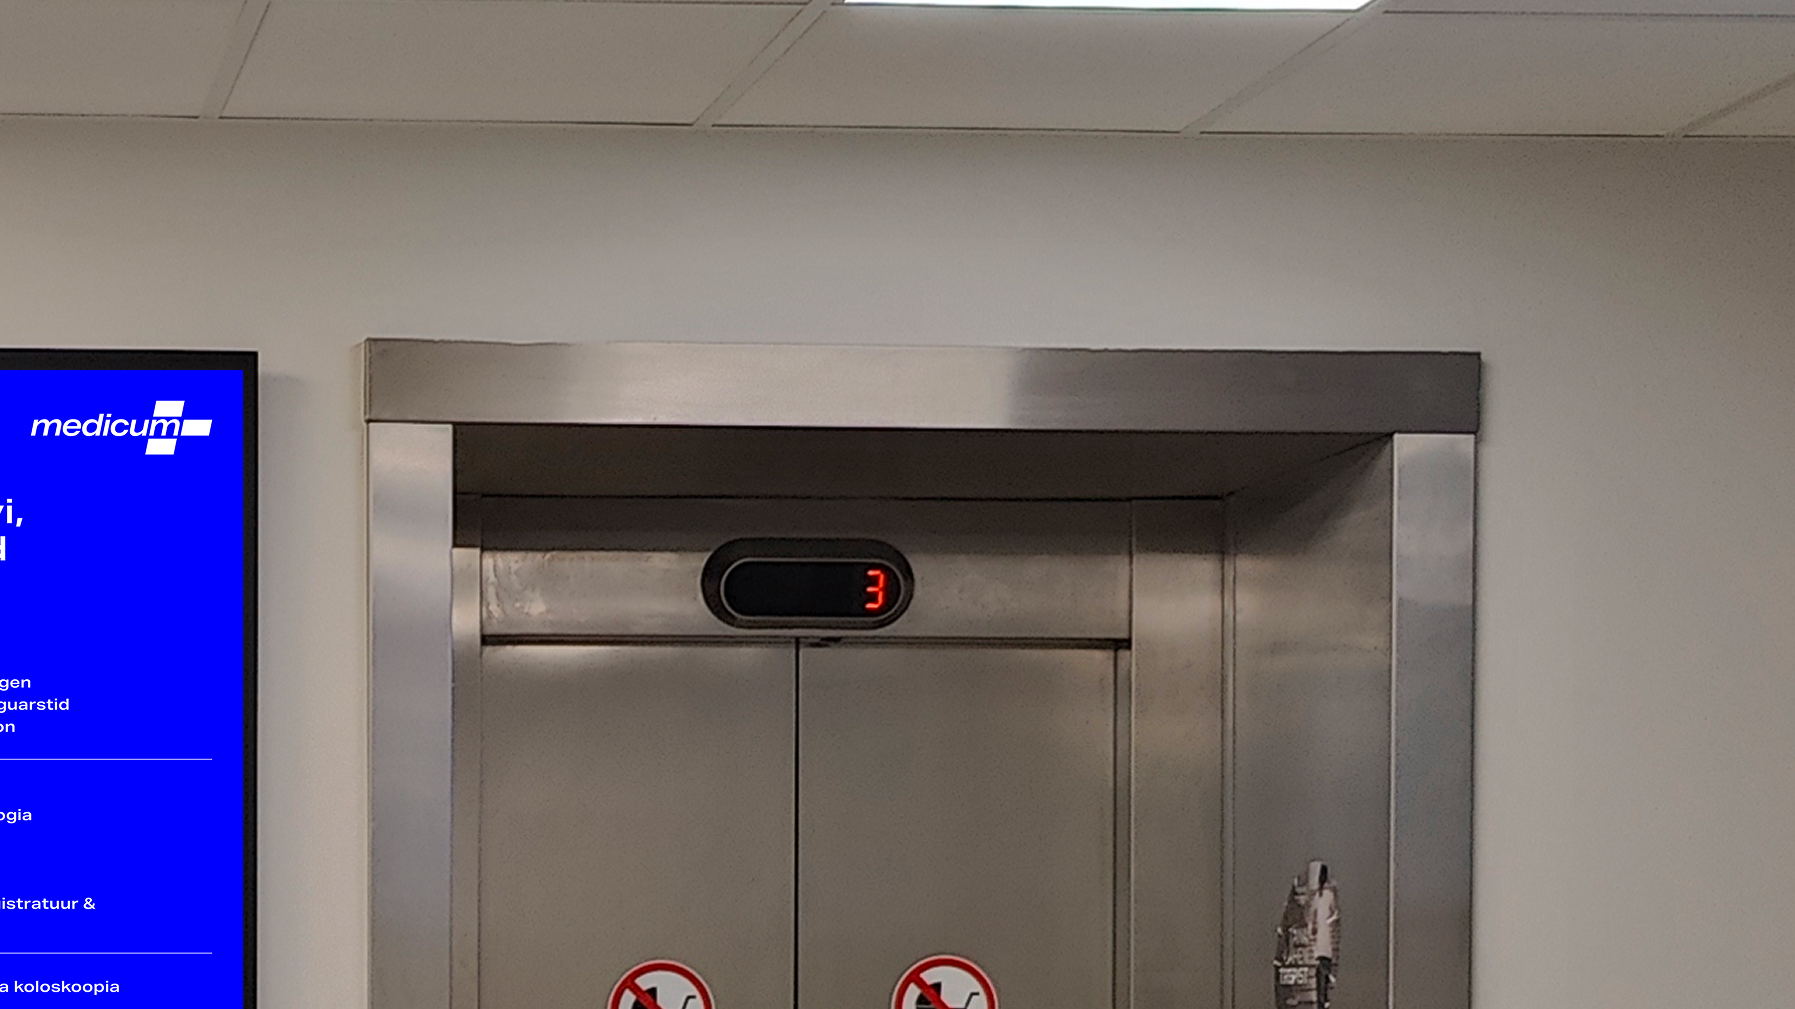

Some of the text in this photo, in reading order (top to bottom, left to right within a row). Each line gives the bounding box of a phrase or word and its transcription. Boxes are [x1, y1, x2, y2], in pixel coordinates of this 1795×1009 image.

[31, 413, 181, 437] medicum
[866, 570, 885, 609] 3
[84, 898, 95, 909] &
[15, 981, 119, 995] koloskoopia
